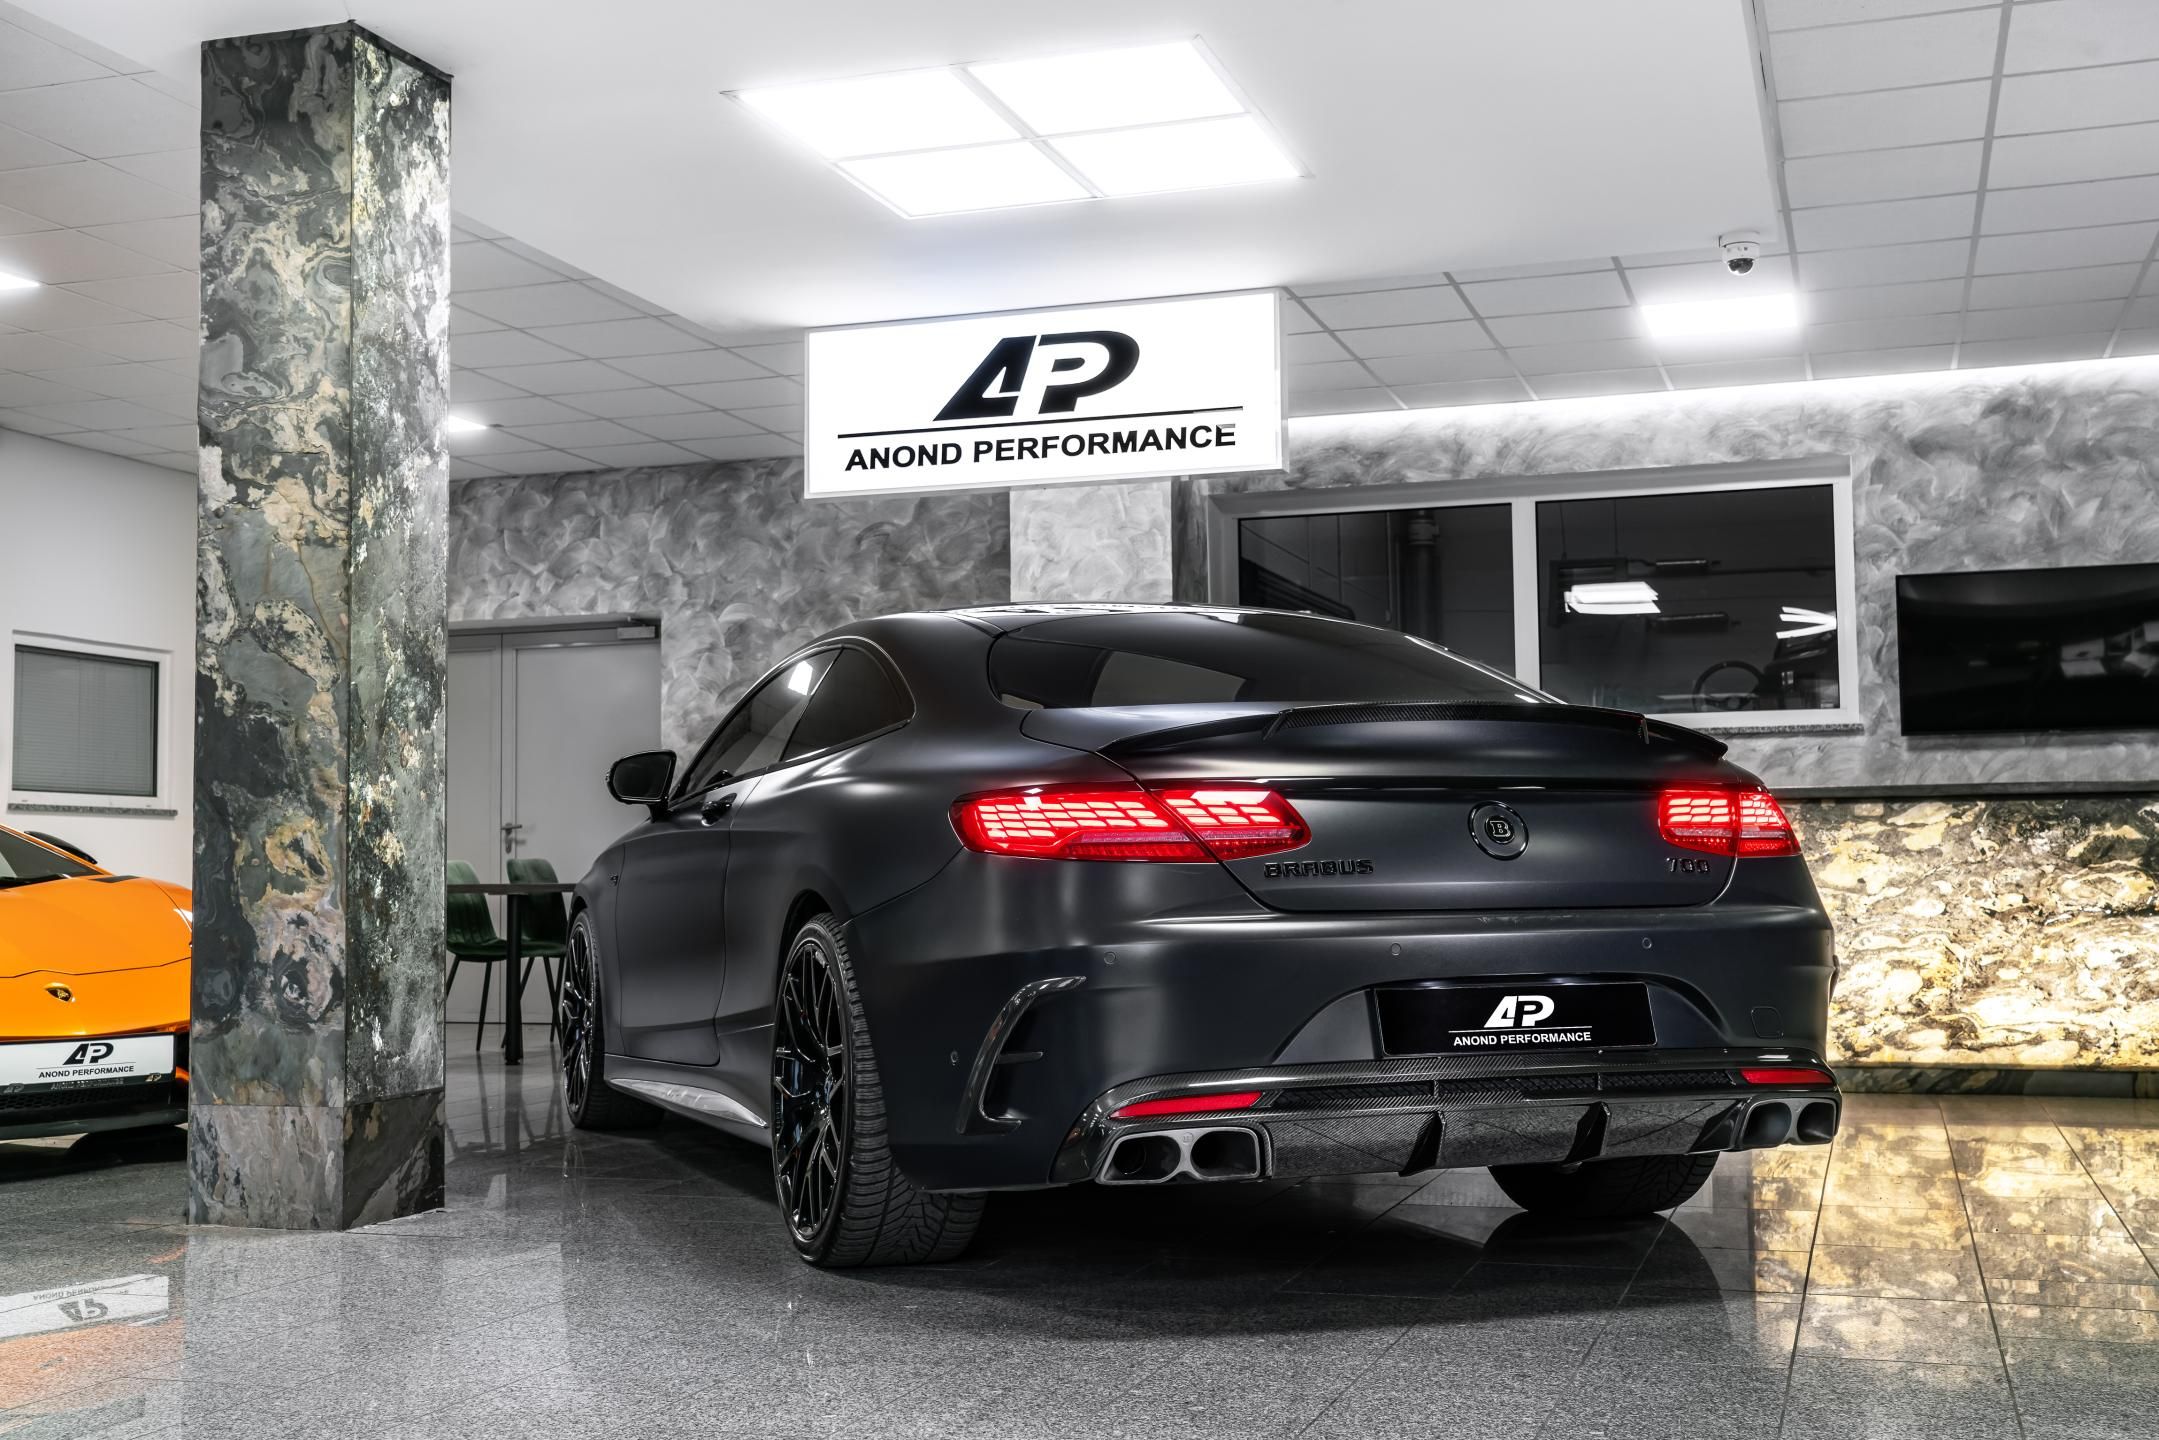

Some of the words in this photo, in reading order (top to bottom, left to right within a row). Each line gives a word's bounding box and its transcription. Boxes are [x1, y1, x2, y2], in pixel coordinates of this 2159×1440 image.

[932, 330, 1141, 422] AP
[844, 442, 963, 472] ANOND
[973, 423, 1237, 463] PERFORMANCE
[1263, 859, 1374, 878] BRABUS
[1666, 857, 1711, 873] 700
[1483, 994, 1555, 1028] AP
[1453, 1035, 1498, 1046] ANOND
[1500, 1031, 1592, 1045] PERFORMANCE
[62, 1042, 114, 1066] AP
[38, 1069, 70, 1078] ANOND
[72, 1065, 135, 1077] PERFORMANCE
